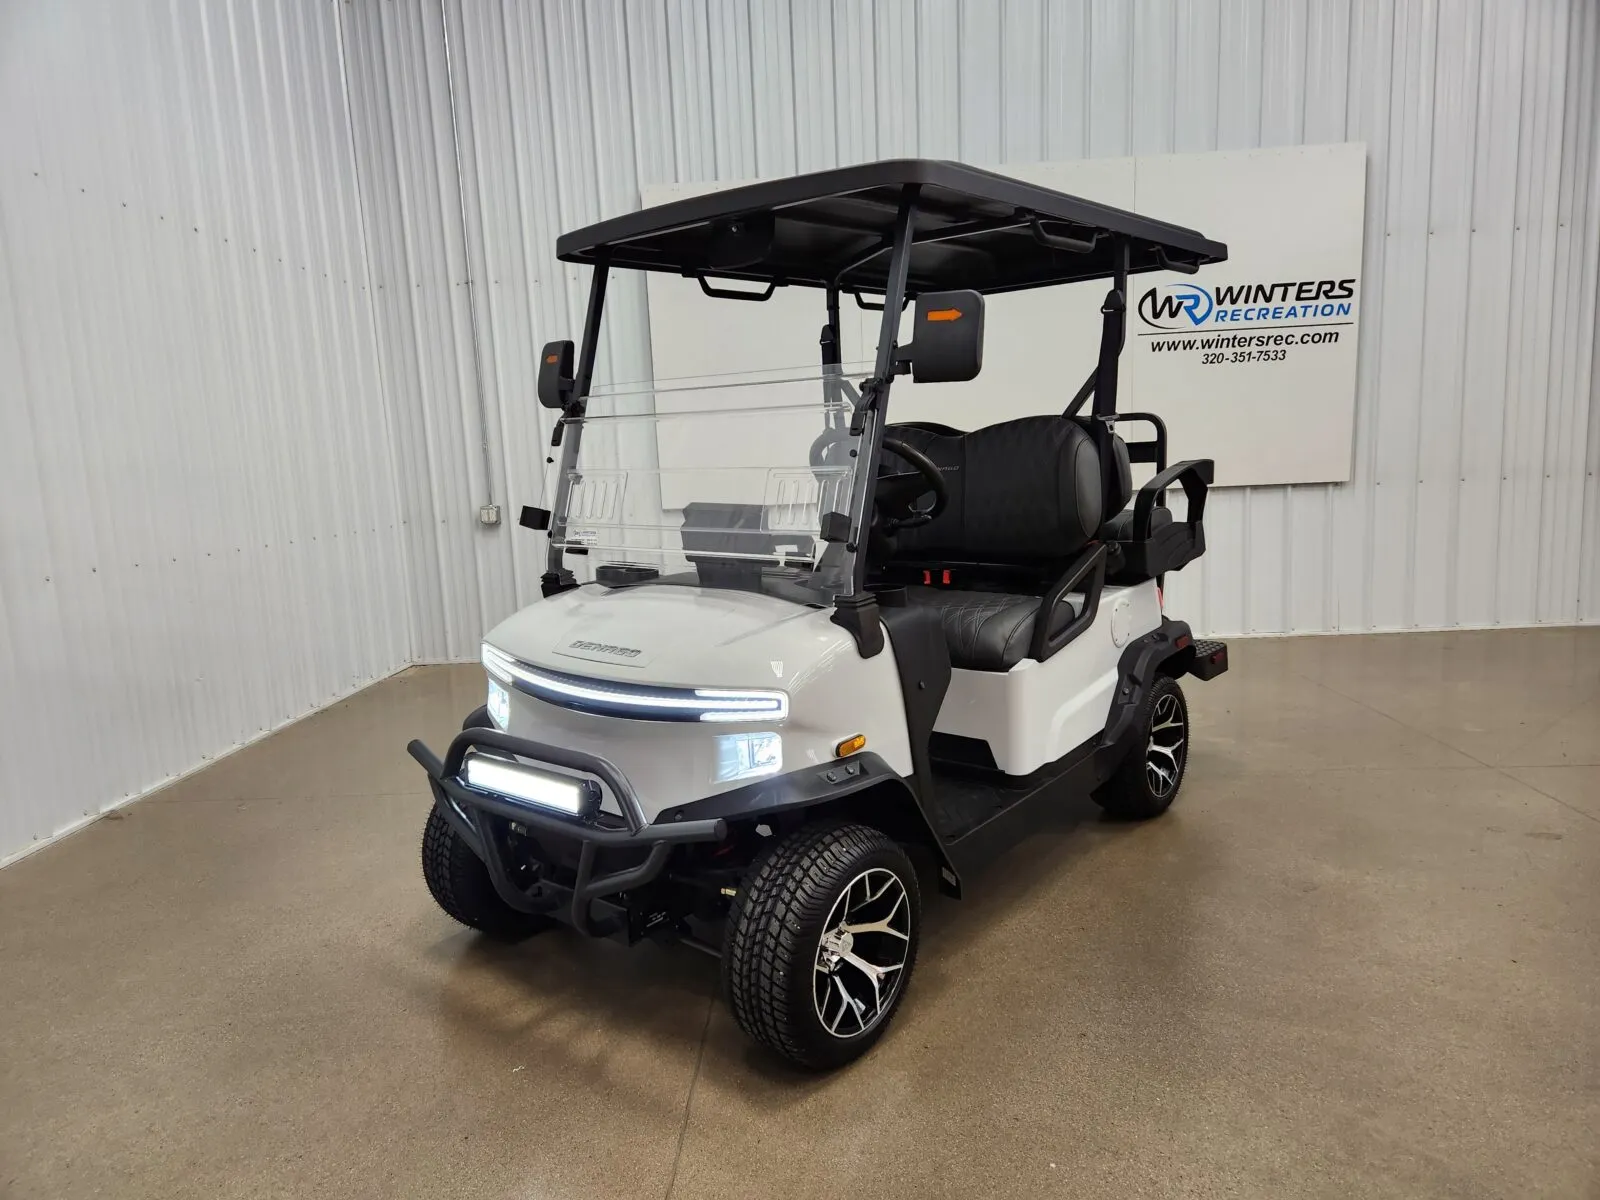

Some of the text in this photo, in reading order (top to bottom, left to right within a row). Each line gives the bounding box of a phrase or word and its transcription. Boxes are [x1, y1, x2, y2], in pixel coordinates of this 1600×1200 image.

[1215, 279, 1356, 306] WINTERS
[1215, 303, 1352, 322] RECREATION
[1151, 331, 1339, 352] www.wintersrec.com
[1201, 349, 1287, 365] 320-351-7533
